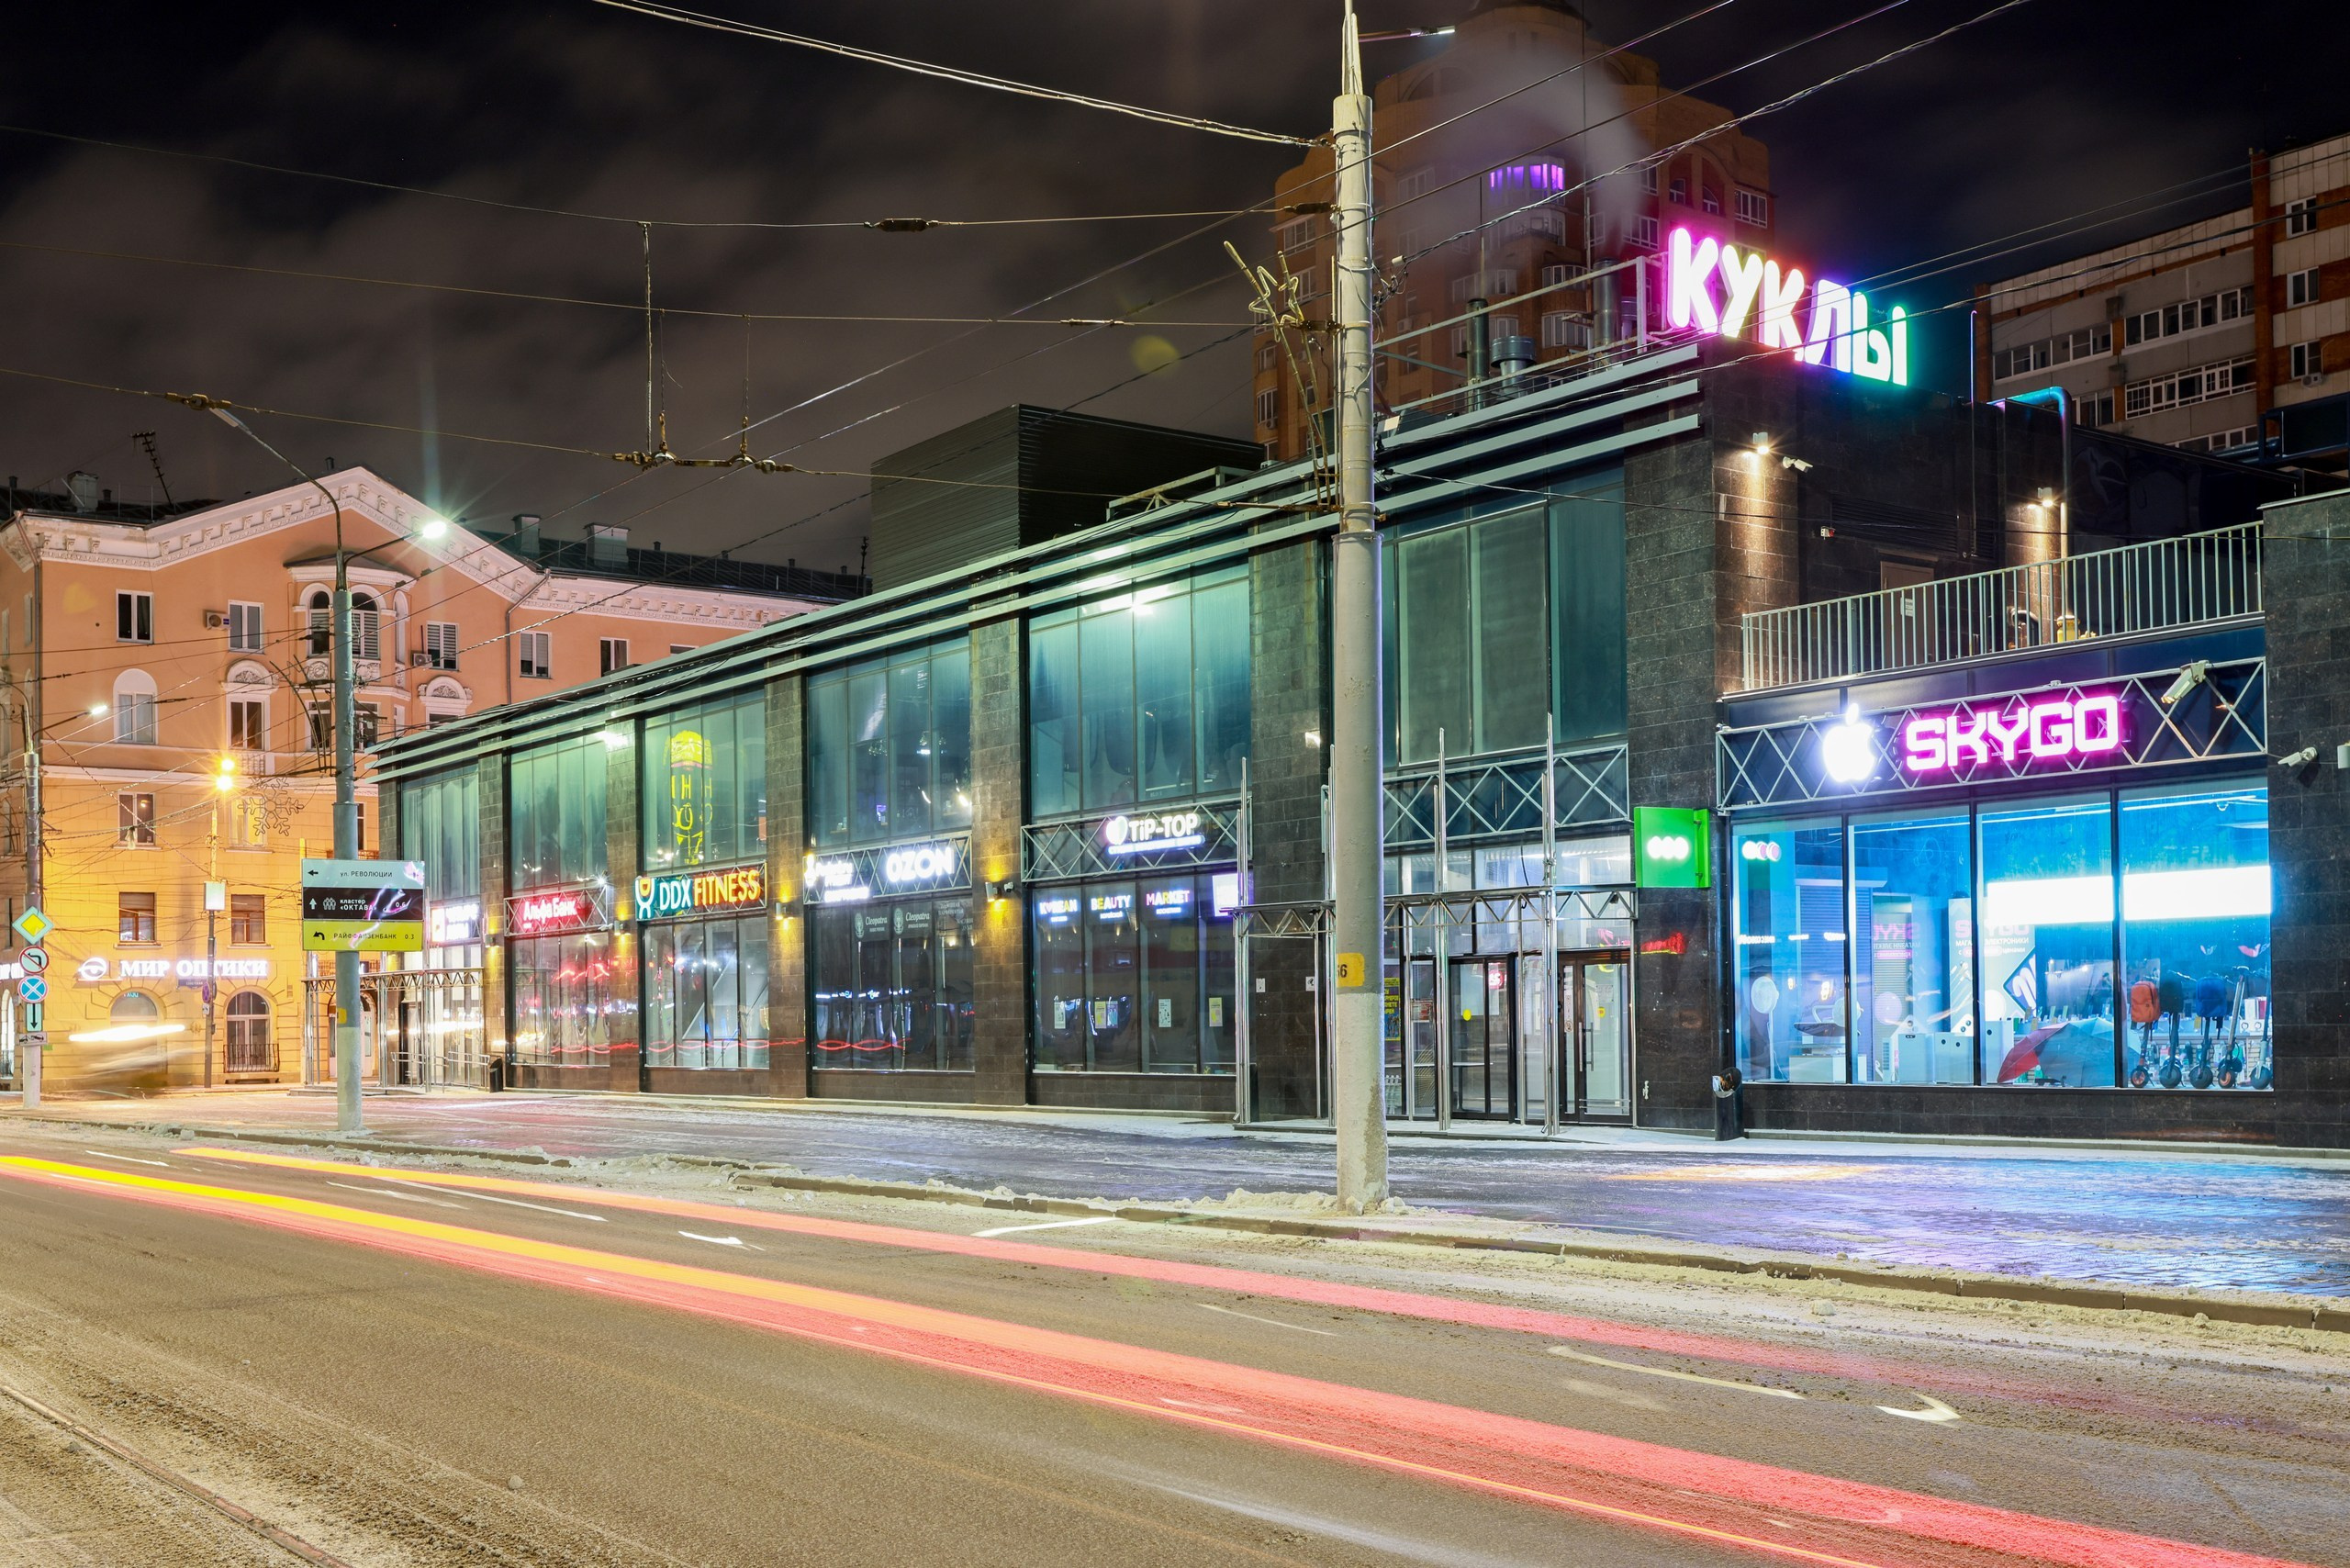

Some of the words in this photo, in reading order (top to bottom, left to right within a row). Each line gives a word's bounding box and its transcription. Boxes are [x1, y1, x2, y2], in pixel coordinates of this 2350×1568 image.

[1668, 228, 1908, 386] КУКЛЫ
[1906, 695, 2121, 772] SKYGO
[886, 846, 954, 883] OZON
[659, 879, 693, 911] DDX
[694, 869, 761, 906] FITNESS
[1146, 890, 1191, 906] MARKET
[1091, 895, 1132, 911] BEAUTY
[865, 916, 888, 927] Cleopatra
[905, 912, 931, 923] Cleopatra
[120, 960, 170, 977] МИР
[176, 959, 268, 977] ОПТИКИ
[1337, 964, 1348, 978] 6
